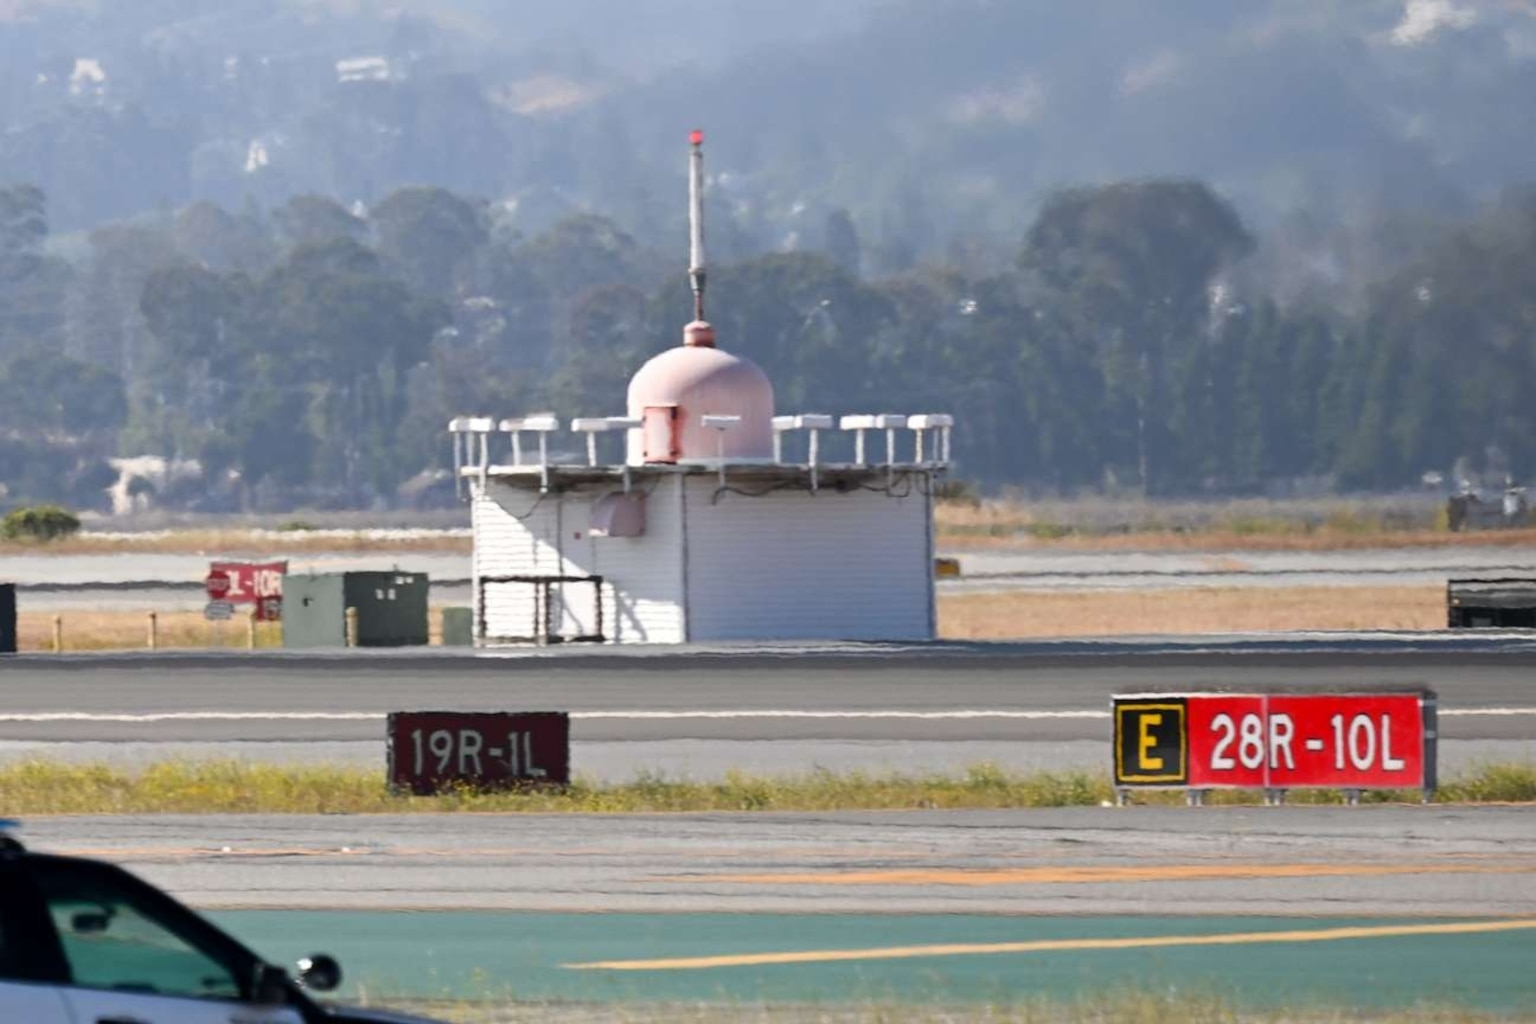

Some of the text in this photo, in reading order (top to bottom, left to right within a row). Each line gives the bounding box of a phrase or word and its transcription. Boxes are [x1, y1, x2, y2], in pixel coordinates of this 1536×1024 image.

[412, 729, 547, 776] 19R-1L
[1139, 714, 1163, 770] E
[1210, 714, 1405, 770] 28R-10L
